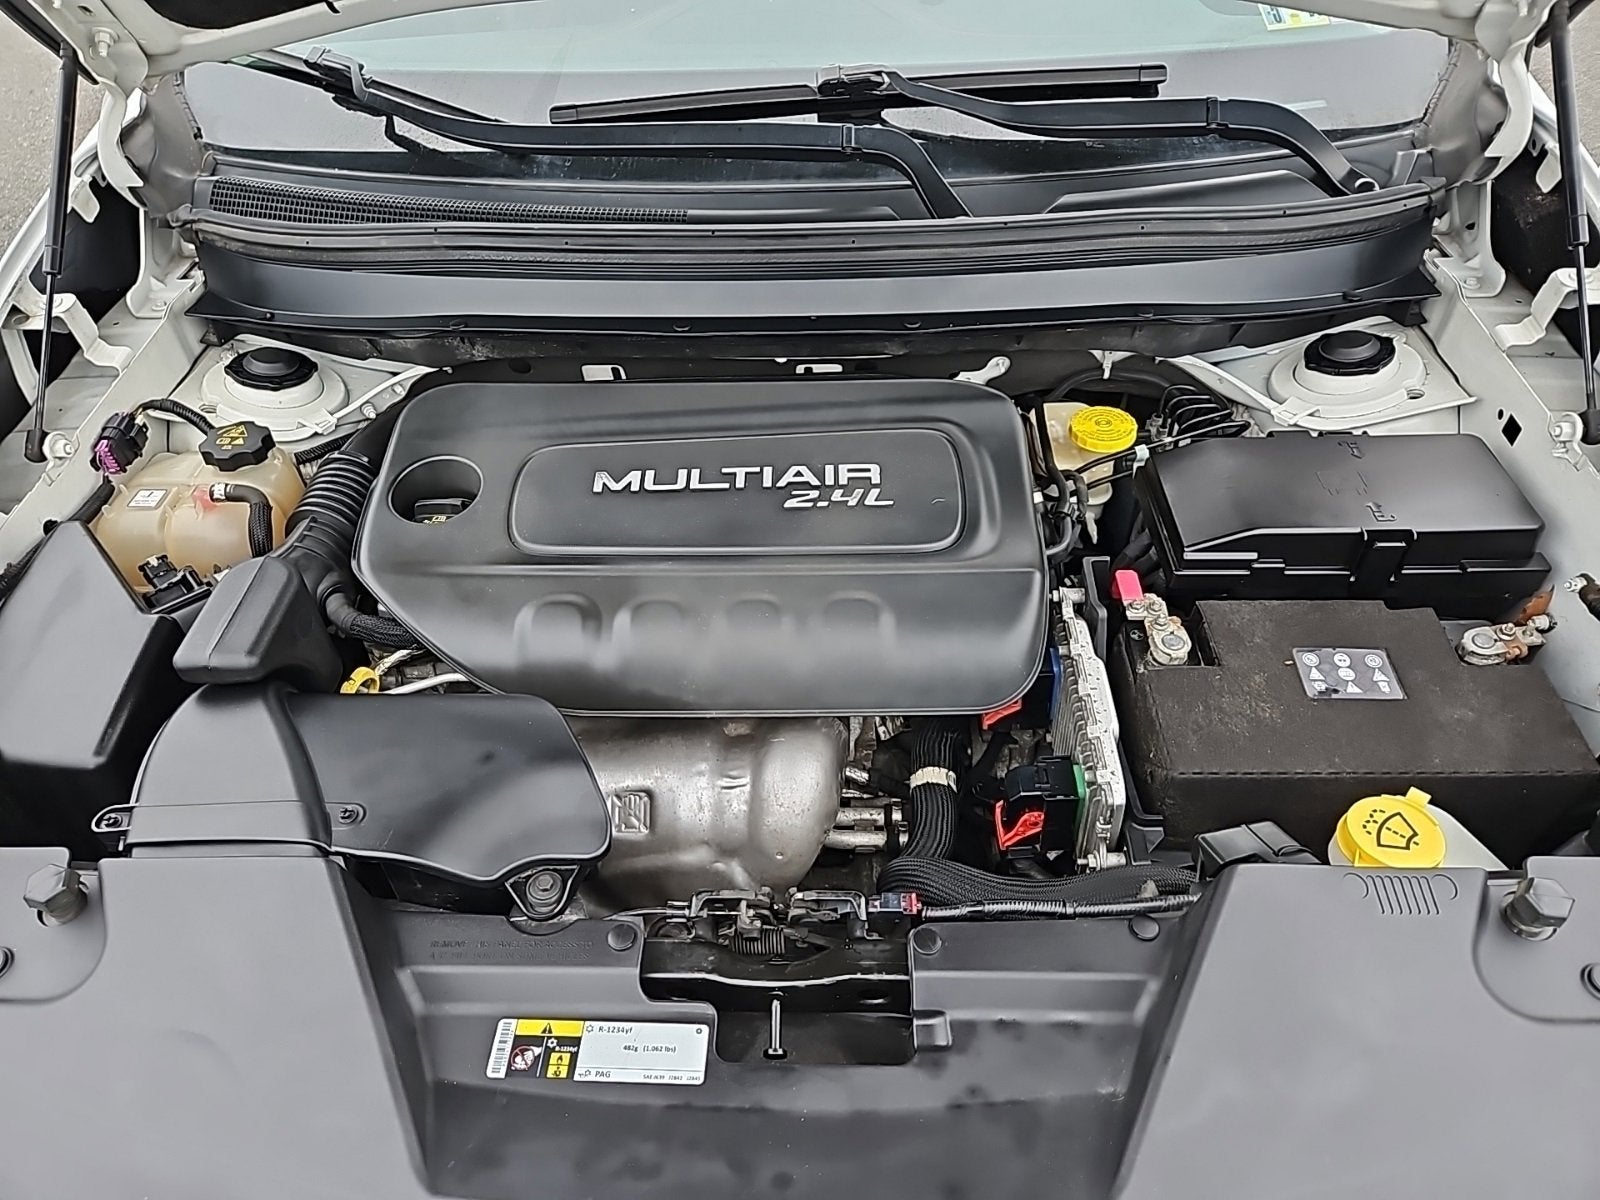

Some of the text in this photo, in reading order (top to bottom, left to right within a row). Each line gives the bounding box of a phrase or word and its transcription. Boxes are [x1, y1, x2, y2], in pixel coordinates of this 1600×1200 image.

[592, 463, 881, 493] MULTIAIR
[782, 487, 895, 510] 2.4L
[598, 1025, 633, 1035] R-1234yf
[594, 1070, 611, 1079] PAG
